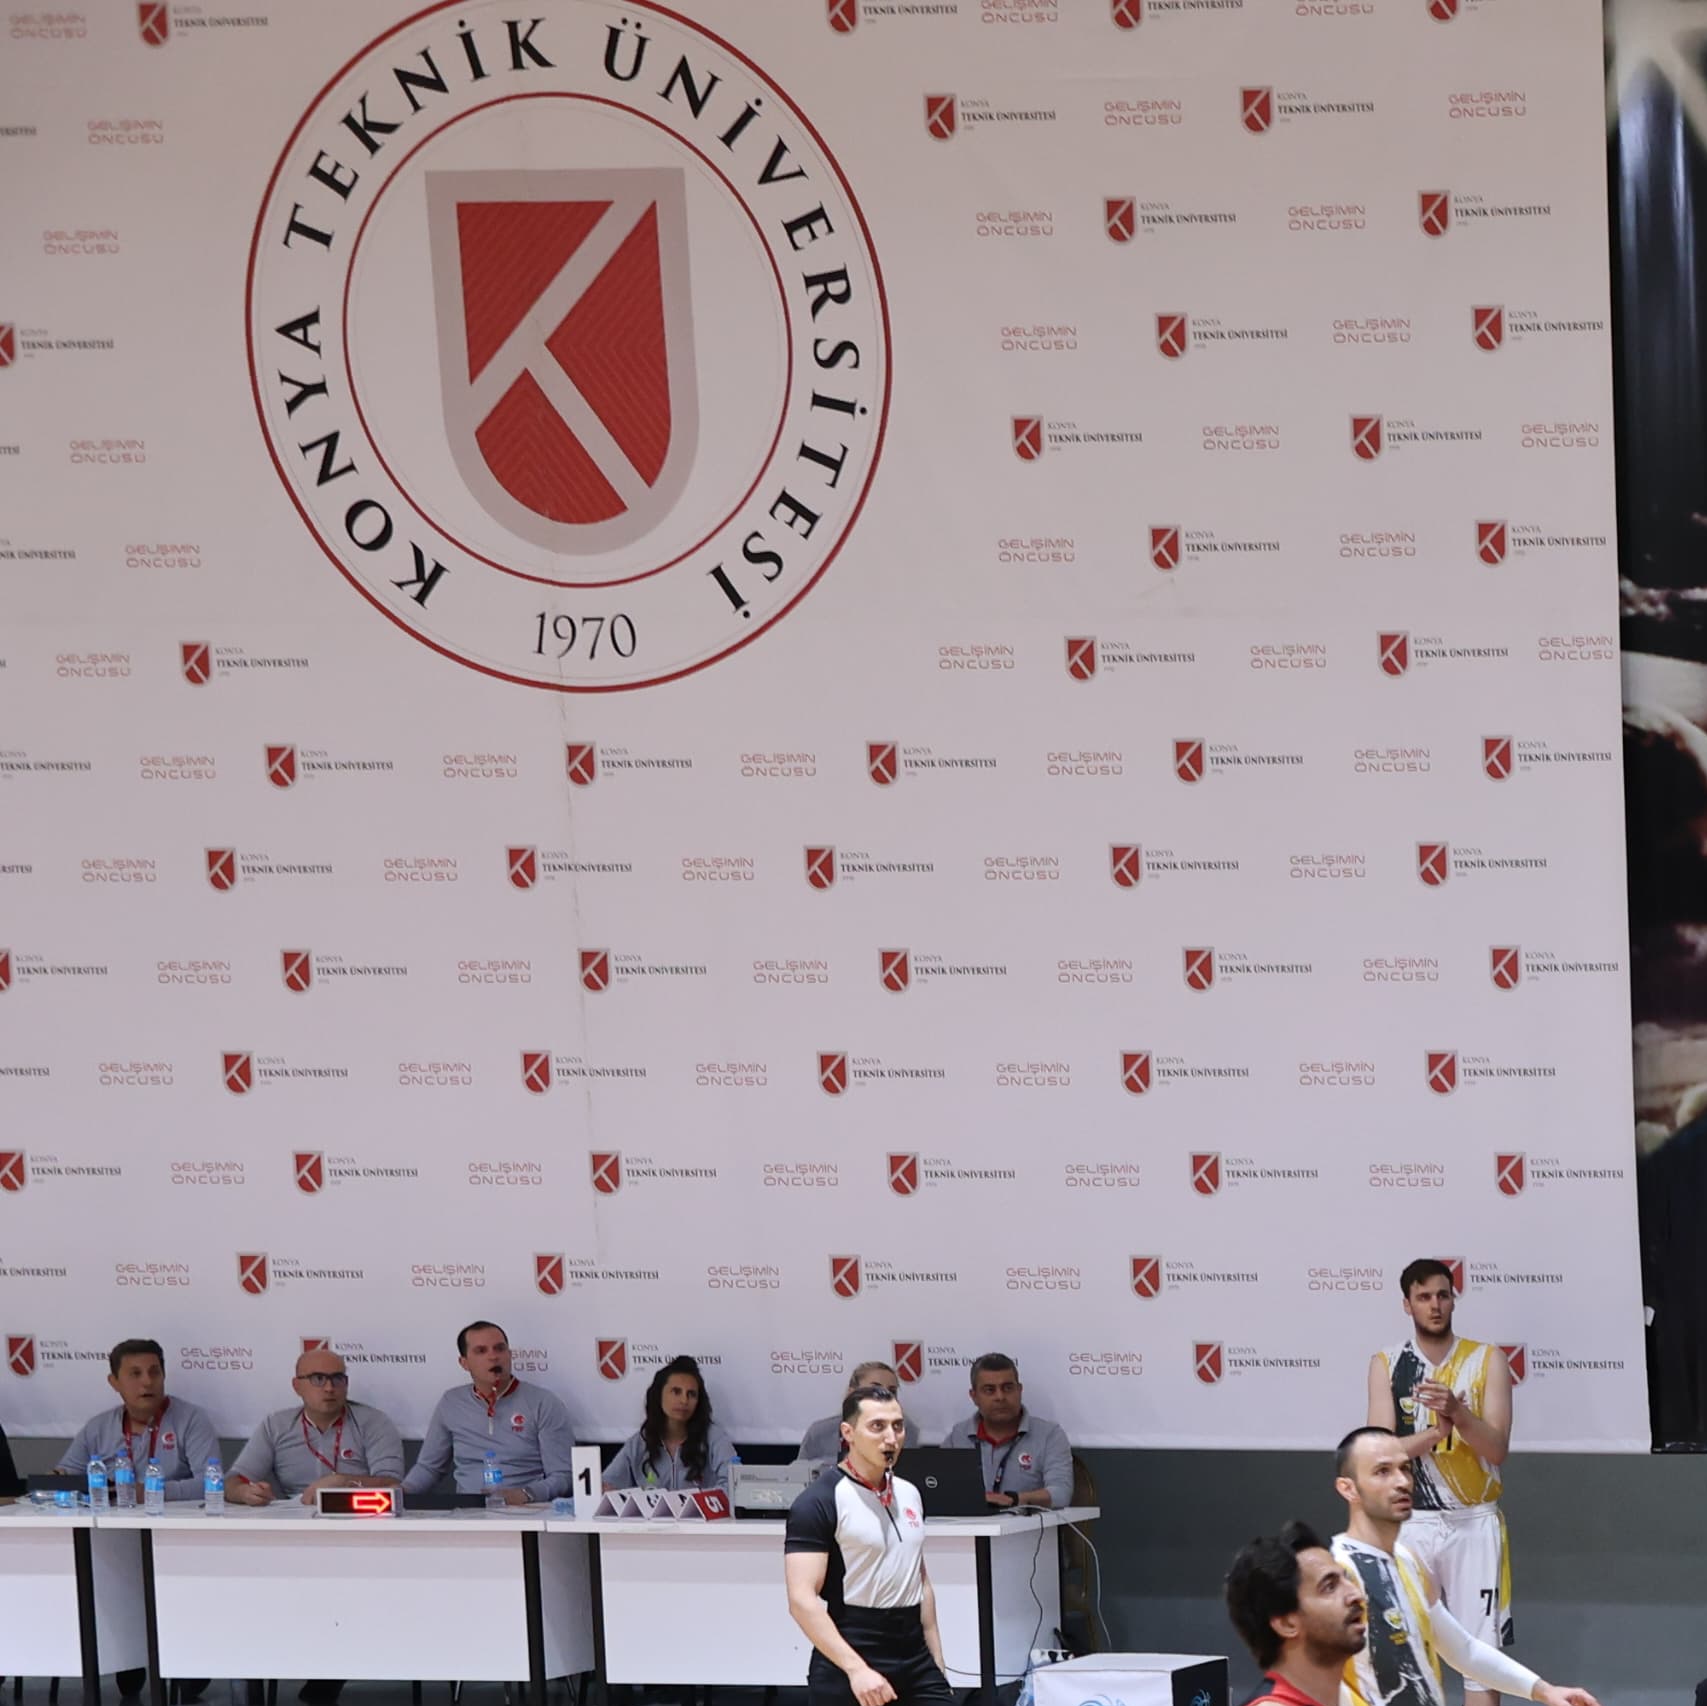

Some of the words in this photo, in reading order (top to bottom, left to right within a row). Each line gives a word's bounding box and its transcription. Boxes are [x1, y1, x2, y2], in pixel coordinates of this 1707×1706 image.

[960, 110, 996, 122] TEKNİK
[995, 110, 1057, 122] ÜNİVERSİTESİ
[283, 18, 557, 252] TEKNİK
[1454, 205, 1490, 218] TEKNİK
[1489, 205, 1551, 218] ÜNİVERSİTESİ
[1140, 213, 1176, 225] TEKNİK
[1175, 213, 1237, 225] ÜNİVERSİTESİ
[603, 15, 868, 620] ÜNİVERSİTESİ
[1508, 321, 1543, 333] TEKNİK
[1543, 321, 1604, 333] ÜNİVERSİTESİ
[1192, 328, 1227, 341] TEKNİK
[1227, 328, 1289, 341] ÜNİVERSİTESİ
[1047, 432, 1082, 444] TEKNİK
[1082, 432, 1143, 444] ÜNİVERSİTESİ
[1386, 430, 1420, 443] TEKNİK
[1420, 430, 1483, 443] ÜNİVERSİTESİ
[275, 306, 450, 611] KONYA
[1184, 541, 1220, 553] TEKNİK
[1220, 541, 1280, 553] ÜNİVERSİTESİ
[1511, 536, 1546, 547] TEKNİK
[1546, 536, 1607, 547] ÜNİVERSİTESİ
[533, 610, 638, 661] 1970
[600, 759, 634, 769] TEKNİK
[634, 759, 693, 769] ÜNİVERSİTESİ
[903, 758, 937, 769] TEKNİK
[937, 758, 997, 769] ÜNİVERSİTESİ
[541, 862, 574, 873] TEKNİK
[572, 862, 633, 873] ÜNİVERSİTESİ
[840, 863, 875, 873] TEKNİK
[875, 863, 934, 873] ÜNİVERSİTESİ
[1145, 860, 1180, 871] TEKNİK
[1179, 860, 1240, 871] ÜNİVERSİTESİ
[914, 965, 948, 976] TEKNİK
[948, 965, 1007, 976] ÜNİVERSİTESİ
[1218, 963, 1253, 974] TEKNİK
[1253, 963, 1313, 974] ÜNİVERSİTESİ
[852, 1068, 886, 1079] TEKNİK
[887, 1068, 946, 1079] ÜNİVERSİTESİ
[1156, 1067, 1190, 1078] TEKNİK
[1190, 1067, 1250, 1078] ÜNİVERSİTESİ
[625, 1167, 658, 1178] TEKNİK
[658, 1167, 717, 1178] ÜNİVERSİTESİ
[923, 1169, 957, 1179] TEKNİK
[956, 1169, 1016, 1179] ÜNİVERSİTESİ
[1225, 1168, 1259, 1179] TEKNİK
[1259, 1168, 1319, 1179] ÜNİVERSİTESİ
[1530, 1169, 1565, 1179] TEKNİK
[1565, 1169, 1624, 1179] ÜNİVERSİTESİ
[569, 1269, 600, 1280] TEKNİK
[601, 1269, 659, 1280] ÜNİVERSİTESİ
[865, 1271, 898, 1282] TEKNİK
[898, 1271, 958, 1282] ÜNİVERSİTESİ
[1166, 1271, 1200, 1283] TEKNİK
[1198, 1271, 1259, 1283] ÜNİVERSİTESİ
[1227, 1358, 1262, 1369] TEKNİK
[1262, 1358, 1321, 1369] ÜNİVERSİTESİ
[1531, 1359, 1565, 1370] TEKNİK
[1565, 1359, 1625, 1370] ÜNİVERSİTESİ
[577, 1466, 592, 1496] 1
[704, 1494, 726, 1514] 5
